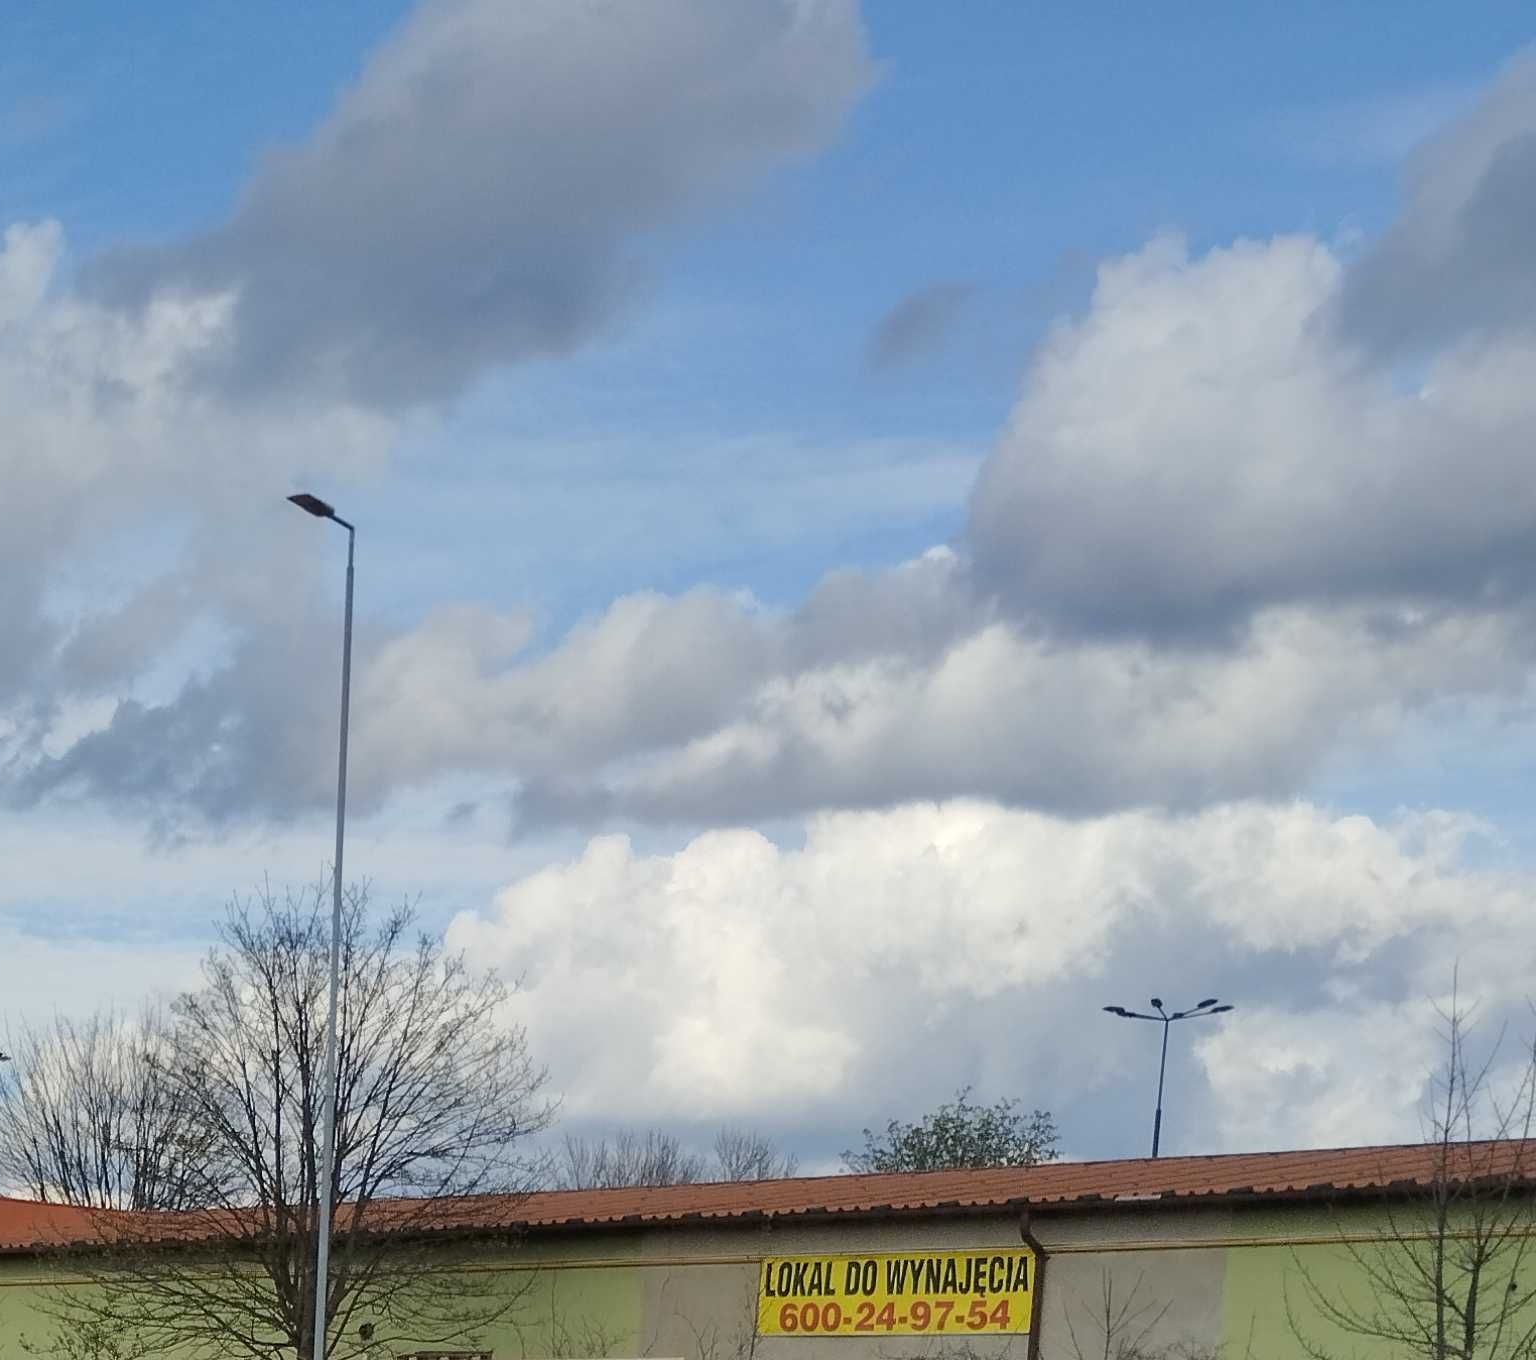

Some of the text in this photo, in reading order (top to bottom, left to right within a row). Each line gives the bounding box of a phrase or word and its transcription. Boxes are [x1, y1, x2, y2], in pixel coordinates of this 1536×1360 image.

[765, 1256, 1029, 1298] LOKAL DO WYNAJĘCIA
[779, 1300, 1011, 1332] 600-24-97-54
